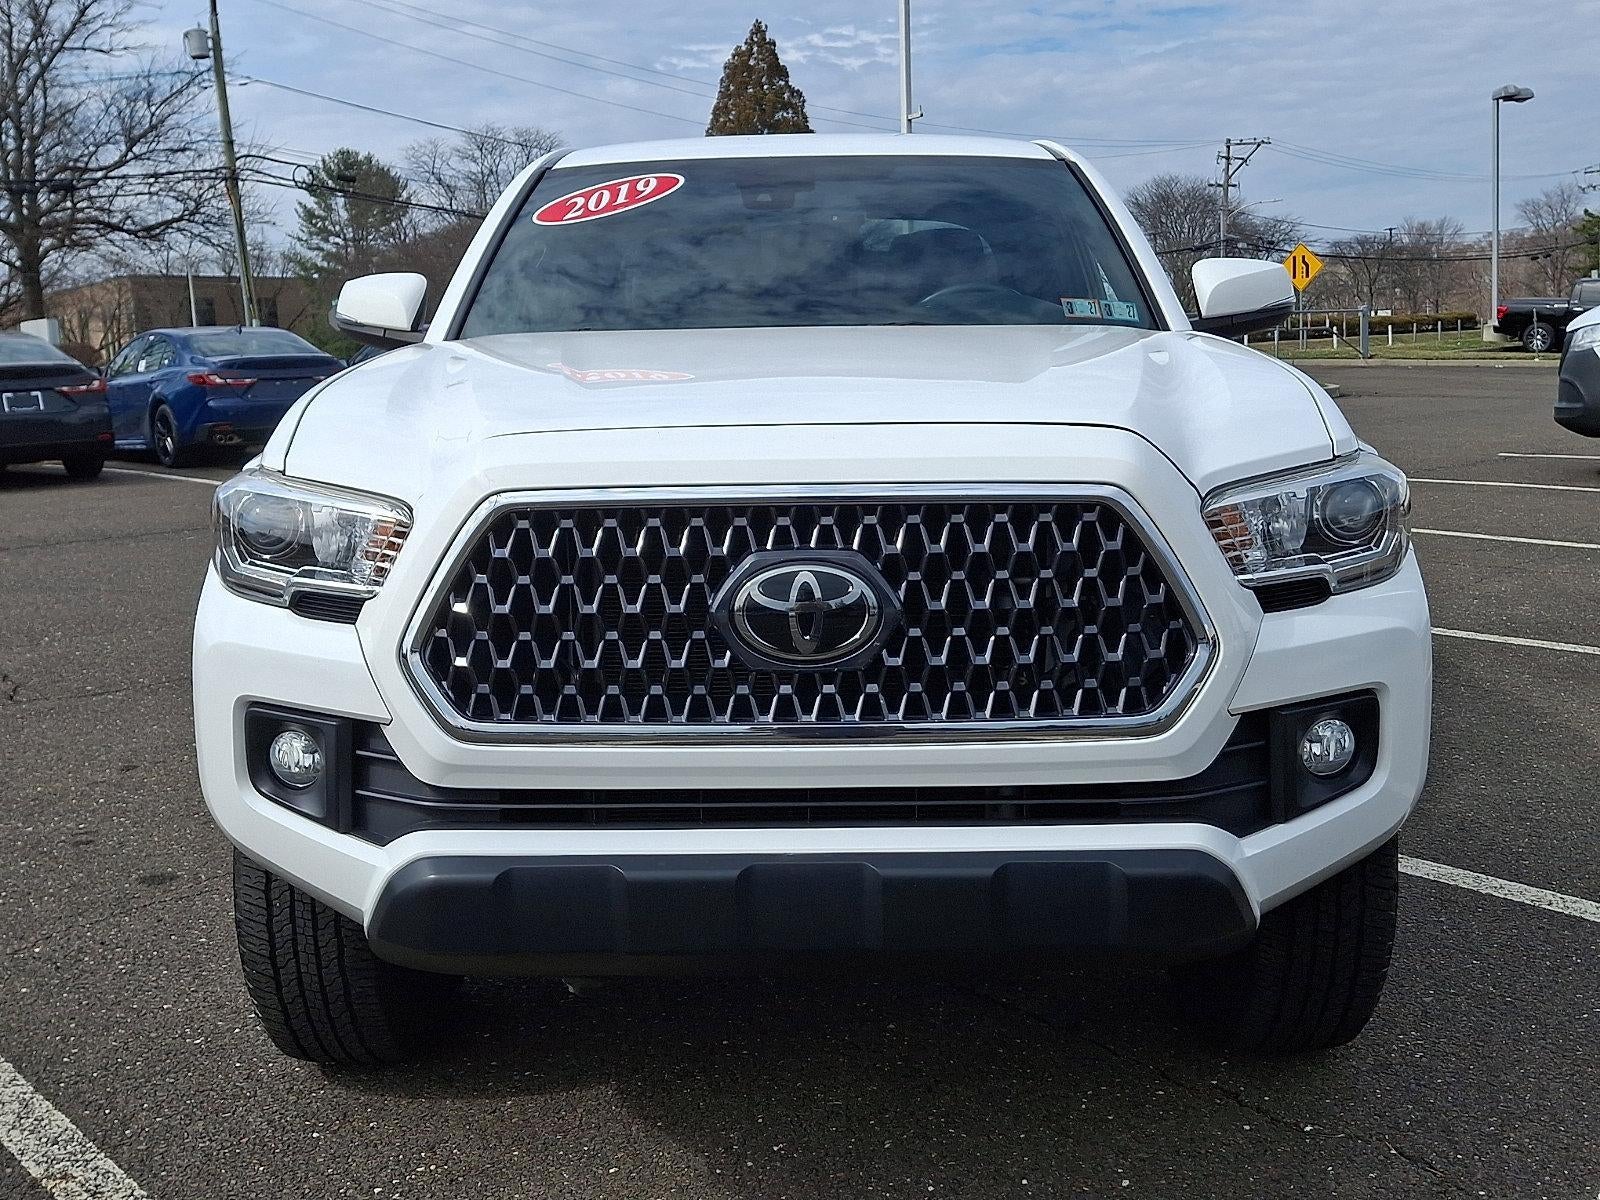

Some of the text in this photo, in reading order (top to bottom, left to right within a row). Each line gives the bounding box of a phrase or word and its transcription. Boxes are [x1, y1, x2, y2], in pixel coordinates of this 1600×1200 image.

[563, 177, 658, 220] 2019
[1066, 301, 1097, 315] 3 27
[1105, 303, 1136, 318] 3 27
